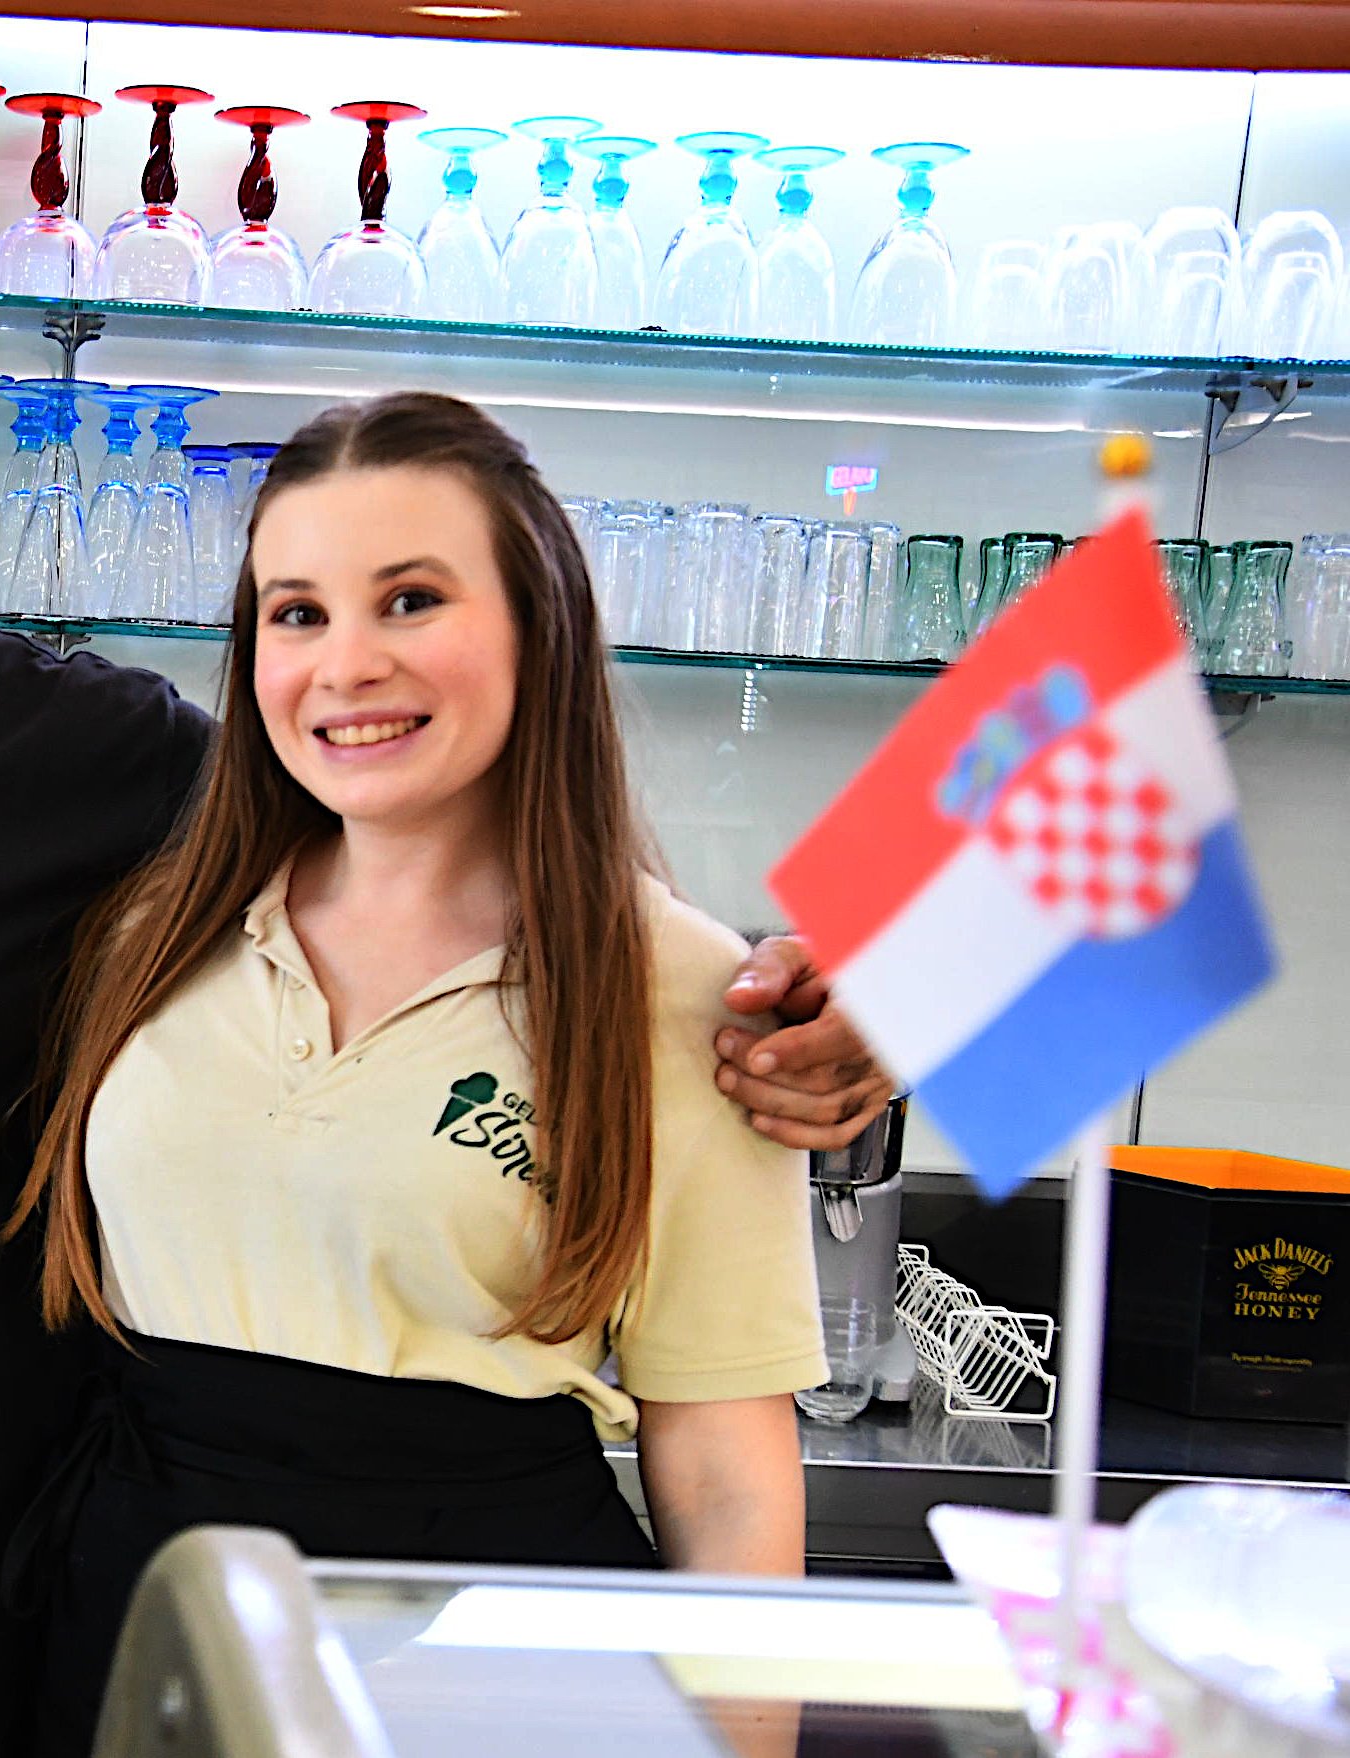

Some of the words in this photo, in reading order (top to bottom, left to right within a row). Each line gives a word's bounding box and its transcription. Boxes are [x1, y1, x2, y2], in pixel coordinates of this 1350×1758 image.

[1233, 1242, 1272, 1271] JACK
[1234, 1282, 1323, 1305] Tennessee
[1233, 1303, 1321, 1321] HONEY
